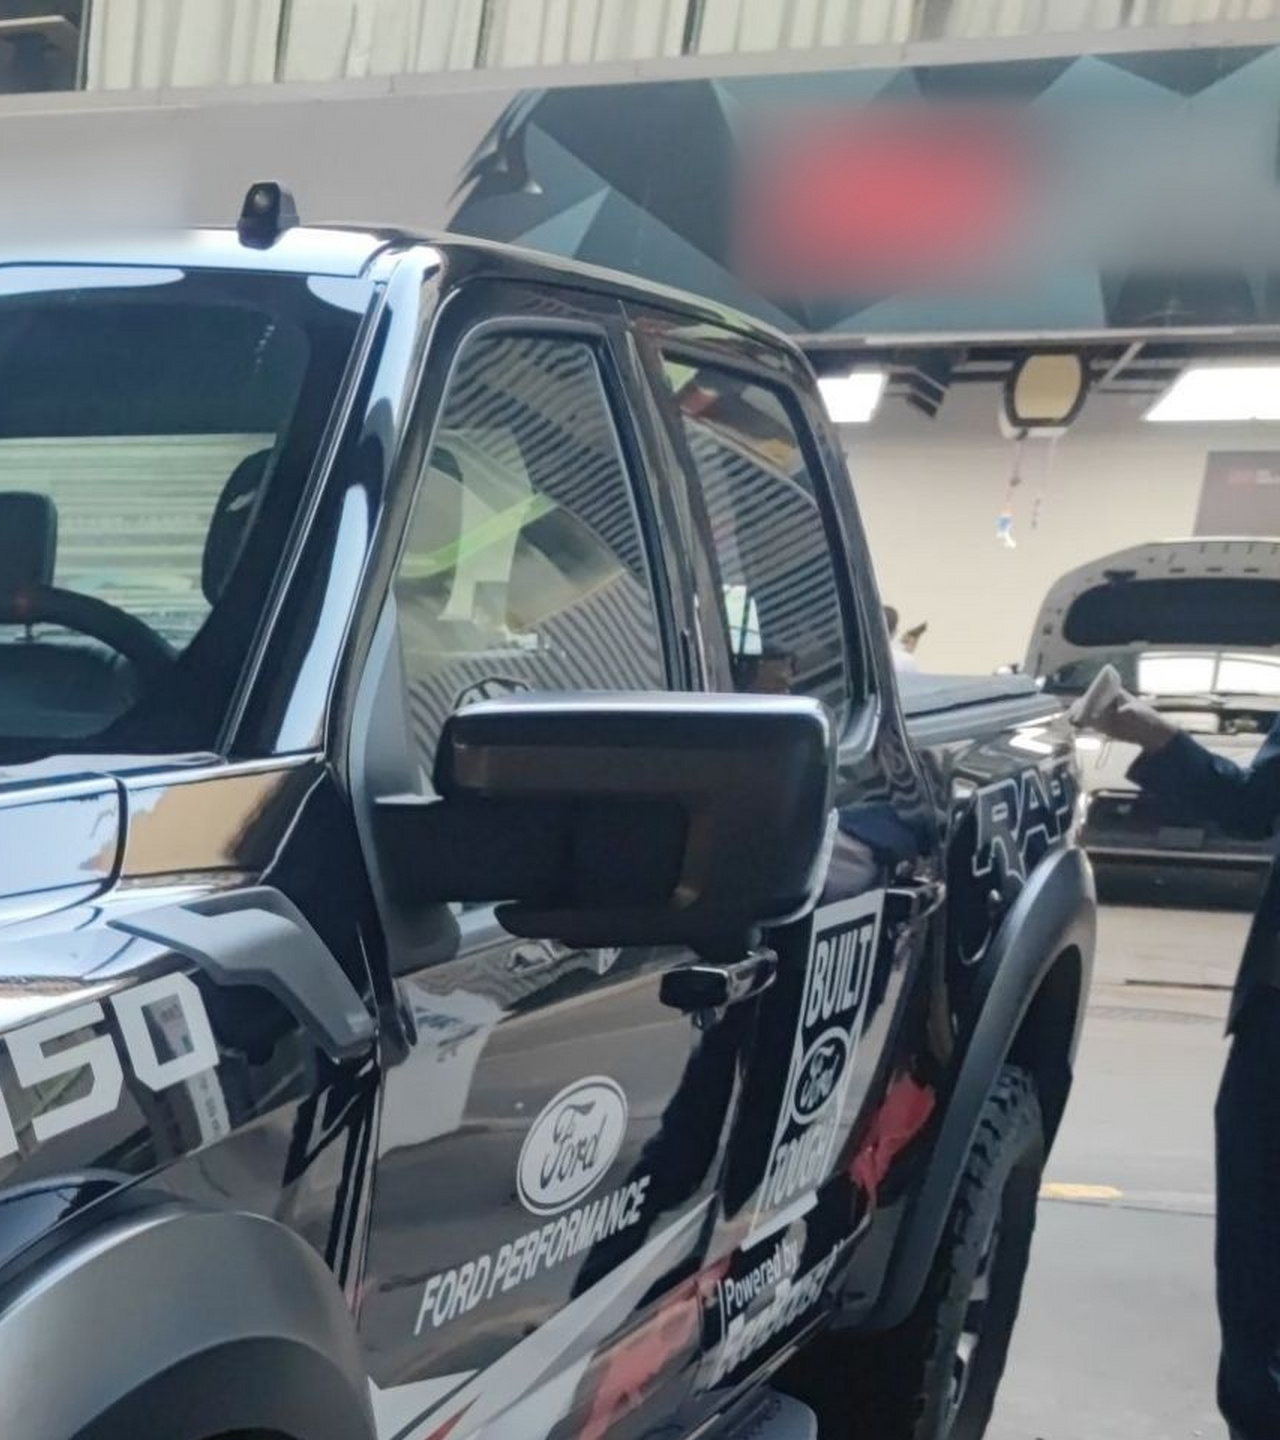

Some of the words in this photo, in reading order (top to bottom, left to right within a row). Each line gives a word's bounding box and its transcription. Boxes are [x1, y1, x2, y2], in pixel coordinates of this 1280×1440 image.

[806, 924, 873, 1028] BUILT
[539, 1100, 609, 1190] Ford
[414, 1254, 491, 1336] FORD
[487, 1175, 651, 1299] PERFORMANCE
[725, 1243, 781, 1315] Powered
[781, 1237, 799, 1279] by
